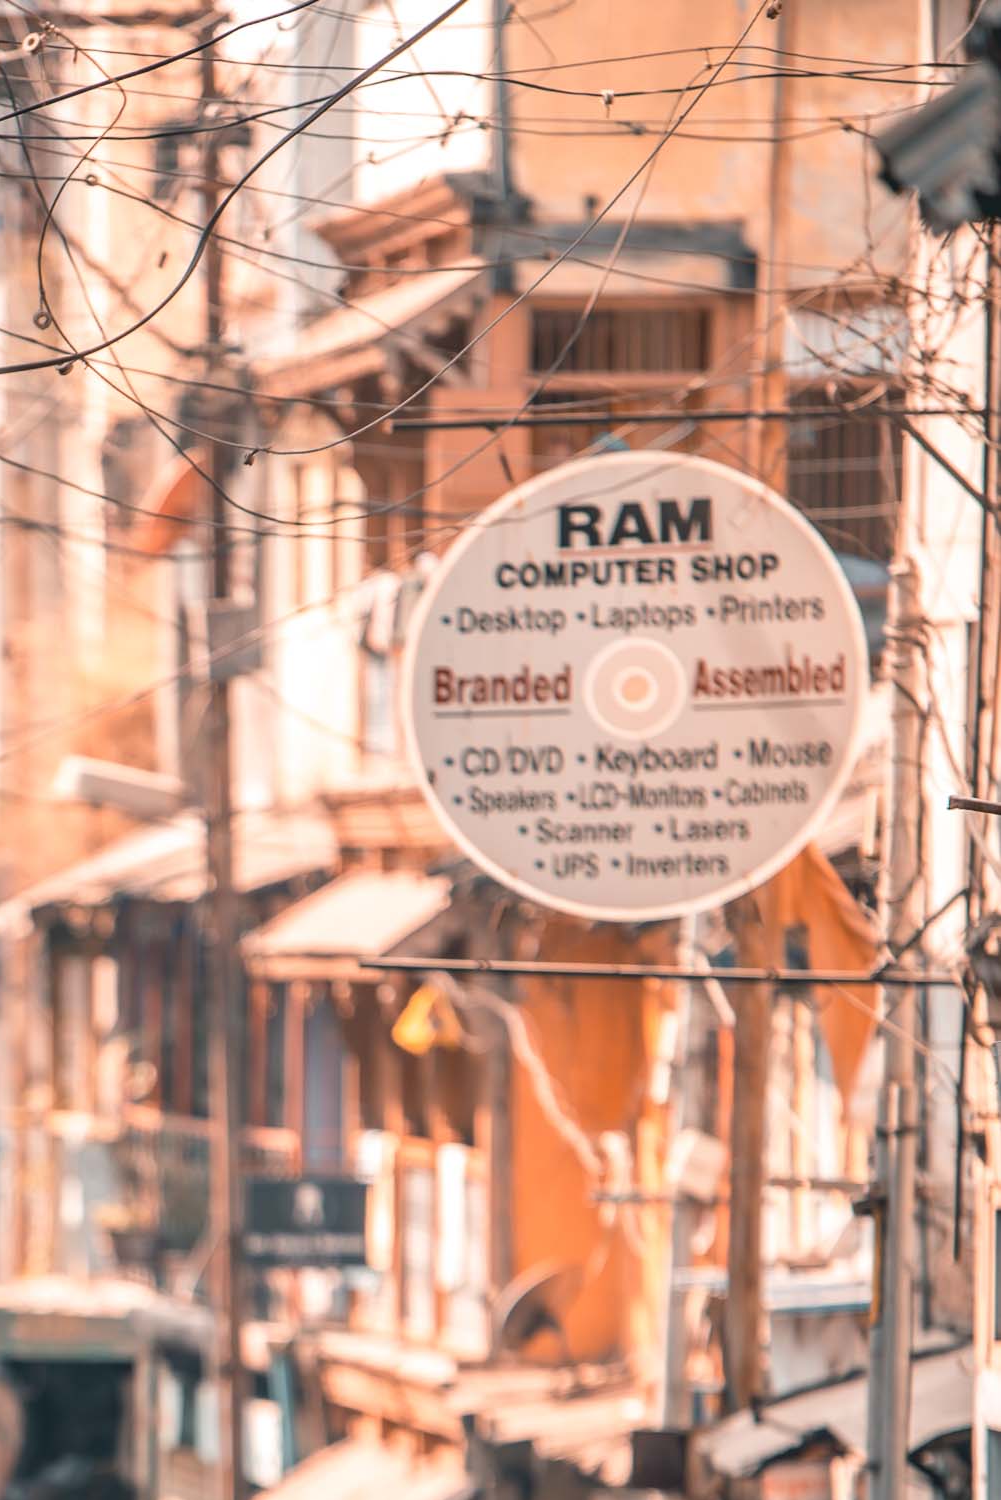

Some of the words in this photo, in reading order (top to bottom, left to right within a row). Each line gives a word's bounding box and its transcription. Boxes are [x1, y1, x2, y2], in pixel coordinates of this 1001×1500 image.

[558, 498, 712, 548] RAM
[495, 557, 676, 588] COMPUTER
[691, 553, 779, 582] SHOP
[457, 606, 566, 636] Desktop
[591, 601, 696, 632] Laptops
[719, 594, 825, 624] Printers
[432, 664, 571, 704] Branded
[692, 652, 845, 697] Assembled
[595, 741, 718, 778] Keyboard
[749, 737, 832, 768] Mouse
[468, 786, 557, 817] Speakers
[534, 817, 632, 844] Scanner
[670, 814, 750, 842] Lasers
[553, 851, 600, 879] UPS
[626, 851, 729, 878] Inverters
